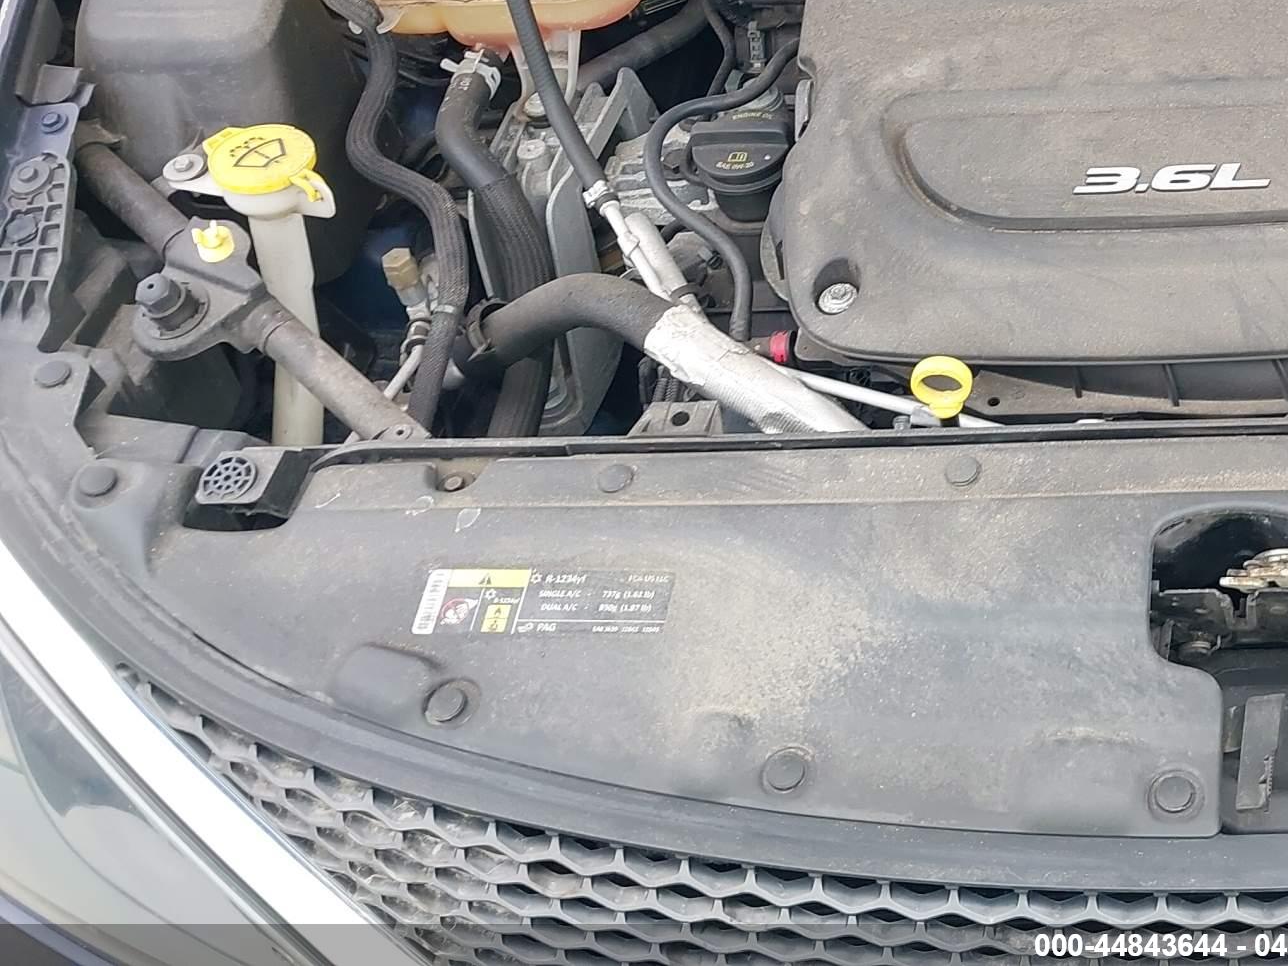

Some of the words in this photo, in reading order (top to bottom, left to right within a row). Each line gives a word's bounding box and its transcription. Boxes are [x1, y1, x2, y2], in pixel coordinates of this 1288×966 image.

[1073, 162, 1272, 195] 3.6L
[566, 589, 582, 599] A/C
[540, 603, 562, 612] DUAL
[562, 603, 579, 612] A/C
[536, 622, 557, 632] PAG
